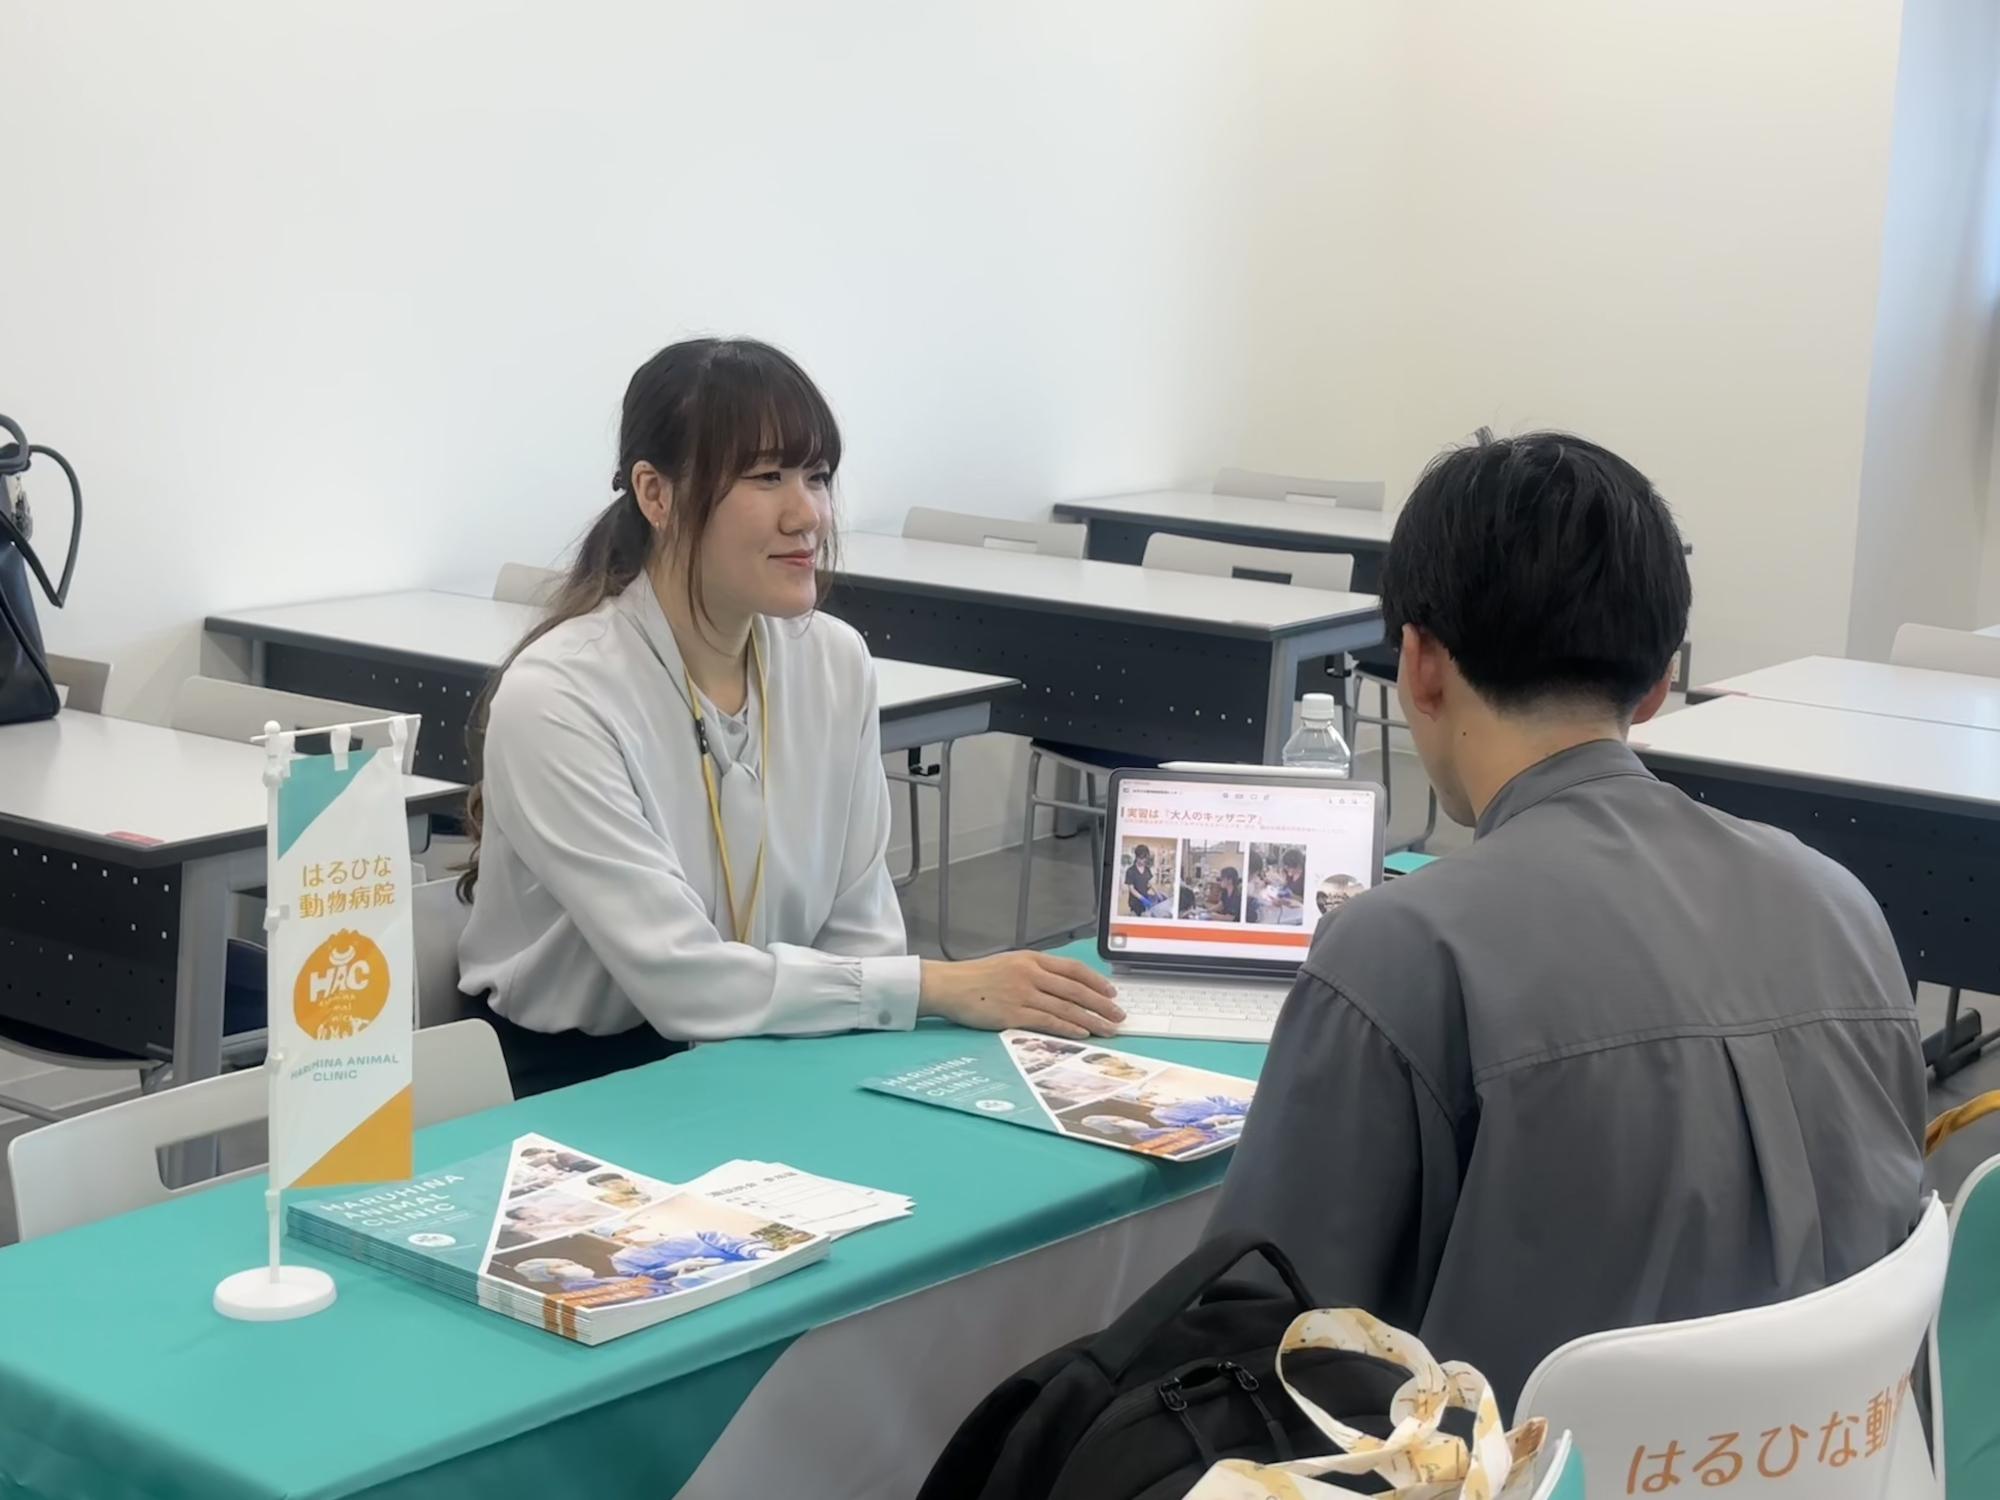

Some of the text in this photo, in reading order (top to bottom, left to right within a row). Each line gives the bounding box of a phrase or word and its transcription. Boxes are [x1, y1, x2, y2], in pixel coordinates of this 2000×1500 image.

[302, 855, 392, 888] はるひな
[299, 882, 395, 919] 動物病院
[310, 960, 370, 1002] HAC
[347, 1054, 399, 1067] ANIMAL
[882, 1055, 979, 1087] HARUHINA
[312, 1069, 358, 1083] CLINIC
[906, 1068, 978, 1093] ANIMAL
[926, 1075, 990, 1098] CLINIC
[319, 1173, 465, 1212] HARUHINA
[344, 1193, 450, 1220] ANIMAL
[361, 1202, 456, 1227] CLINIC
